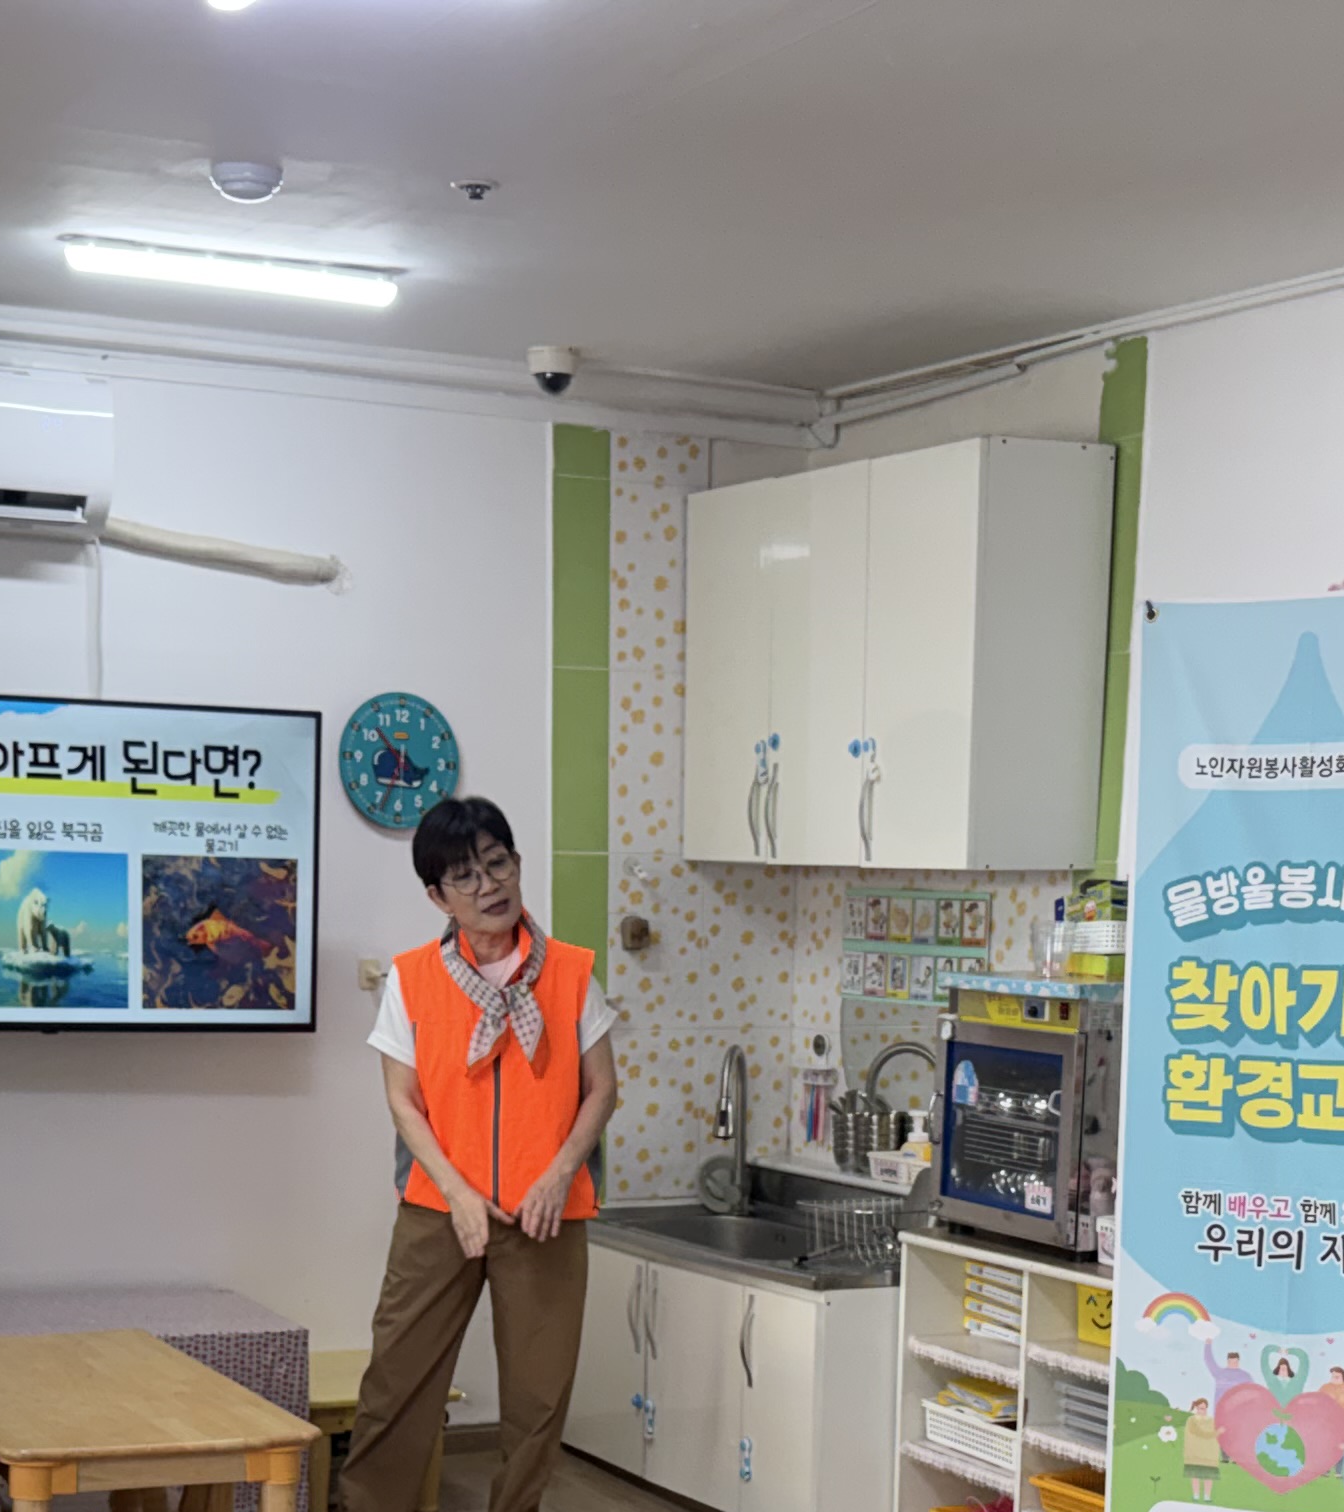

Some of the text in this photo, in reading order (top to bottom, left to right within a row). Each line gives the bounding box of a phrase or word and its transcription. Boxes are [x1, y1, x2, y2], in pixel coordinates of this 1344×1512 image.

[378, 713, 391, 727] 11
[394, 709, 410, 723] 12
[419, 718, 425, 731] 1
[362, 728, 379, 742] 10
[431, 736, 441, 749] 2
[354, 750, 363, 762] 9
[122, 739, 262, 798] 된다면?
[437, 759, 446, 771] 3
[359, 773, 368, 786] 8
[429, 780, 438, 792] 4
[375, 791, 384, 803] 7
[414, 795, 423, 808] 5
[393, 799, 403, 812] 6
[61, 821, 103, 843] 북극곰
[252, 825, 262, 838] 수
[1181, 1190, 1222, 1216] 함께
[1226, 1193, 1291, 1219] 배우고
[1299, 1199, 1338, 1227] 함께
[1197, 1225, 1304, 1270] 우리의
